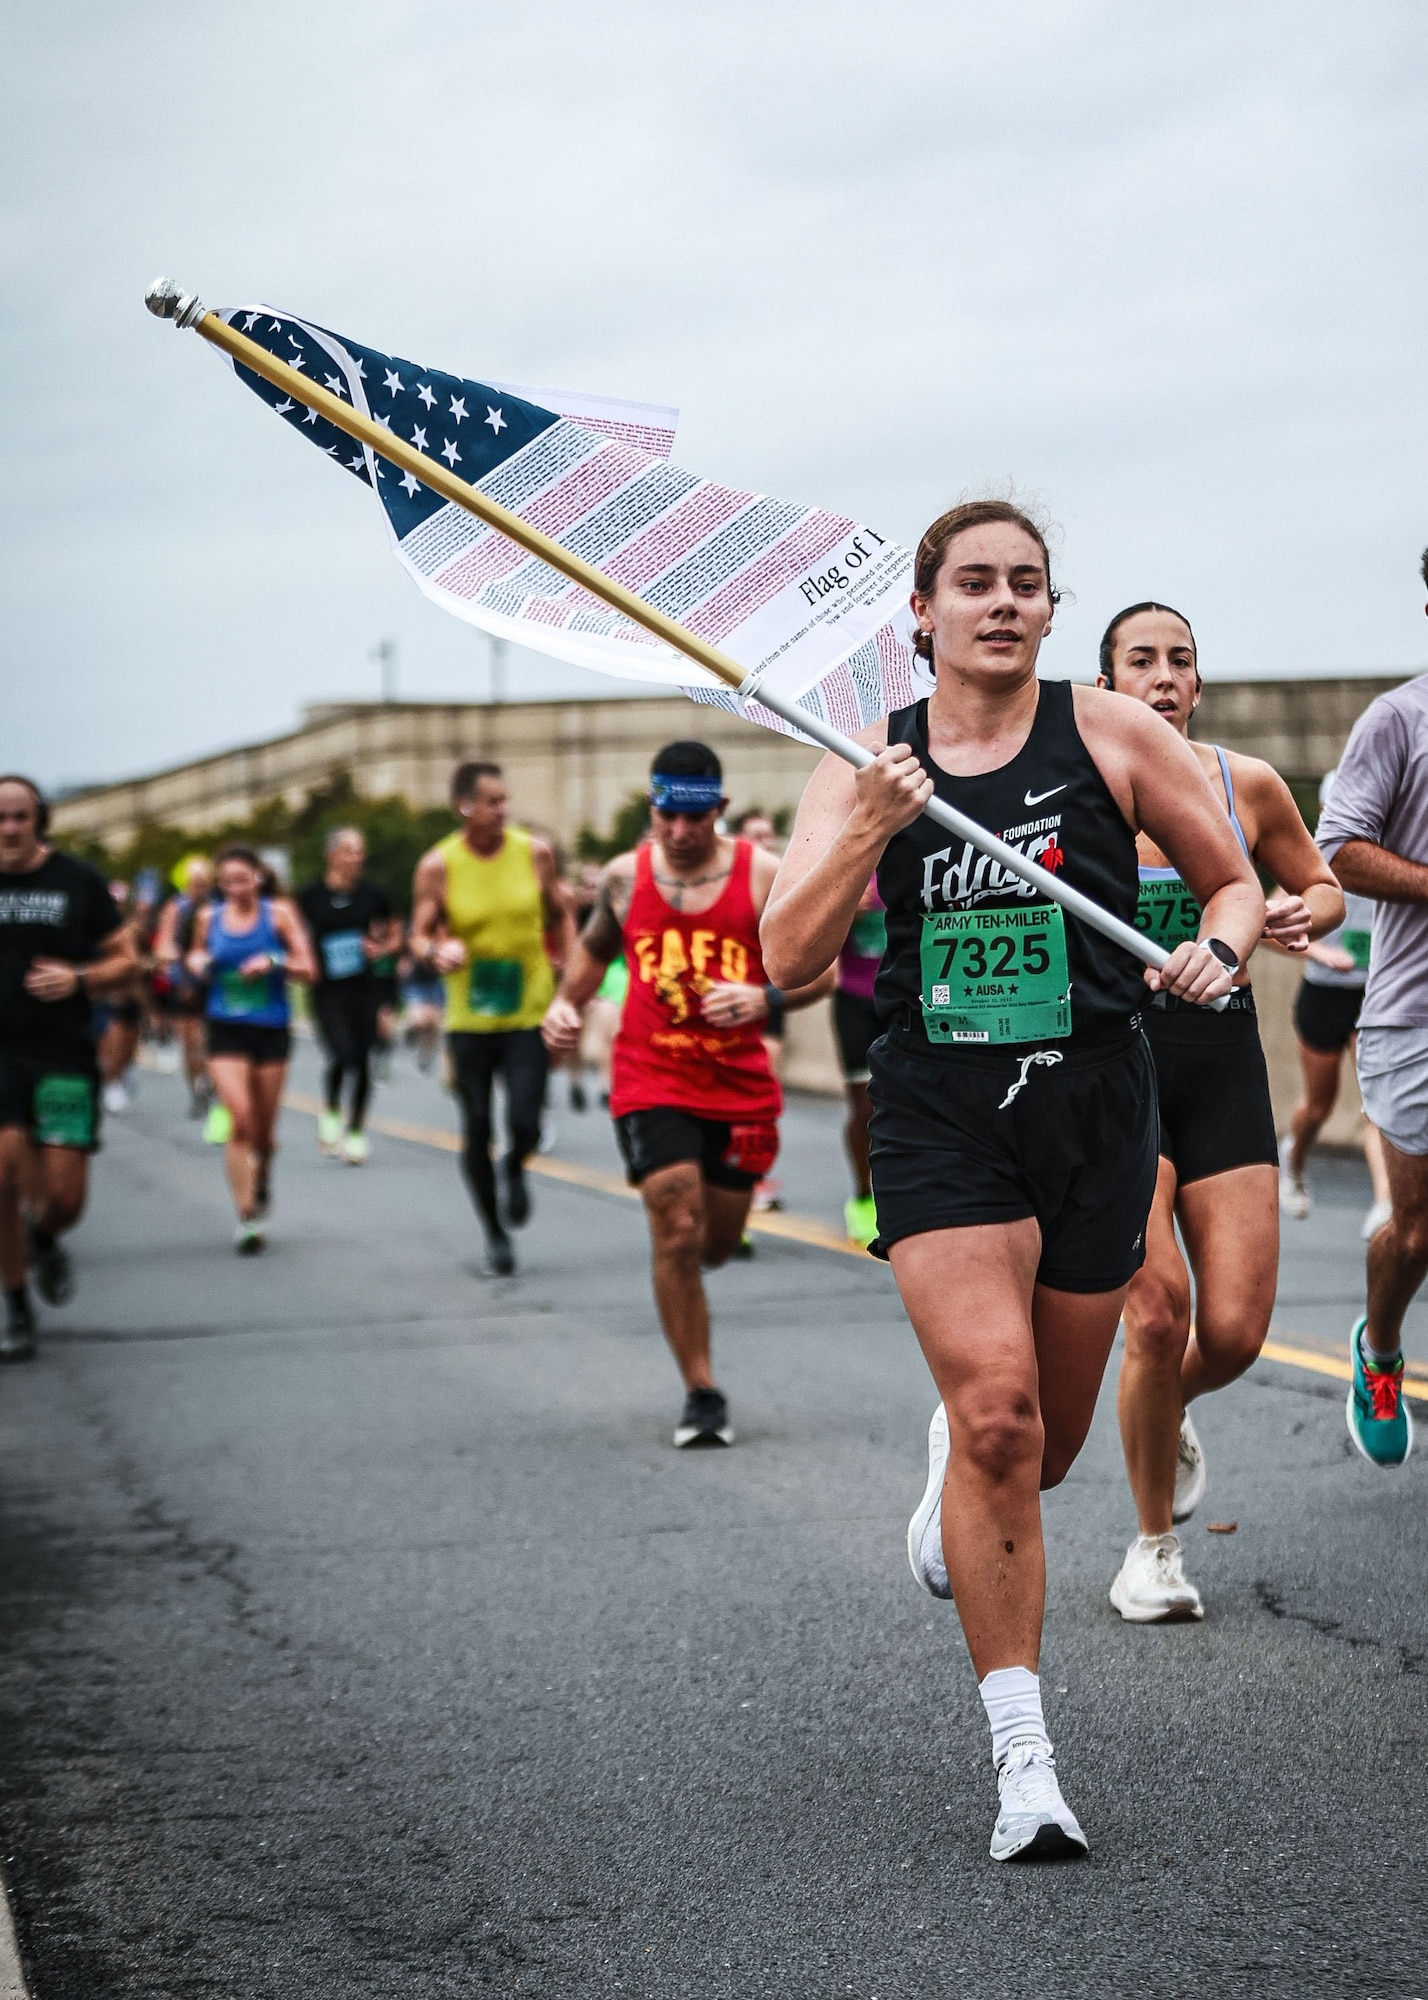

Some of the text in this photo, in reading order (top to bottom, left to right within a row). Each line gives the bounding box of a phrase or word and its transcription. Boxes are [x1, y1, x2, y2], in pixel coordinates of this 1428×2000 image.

[799, 566, 849, 606] Flag
[845, 536, 872, 568] of
[876, 580, 893, 597] shall
[892, 562, 912, 581] never
[765, 651, 781, 664] from
[779, 642, 791, 652] the
[790, 627, 809, 644] names
[815, 608, 832, 622] those
[831, 596, 846, 608] who
[846, 570, 875, 597] perished
[882, 550, 896, 562] the
[841, 602, 854, 614] and
[853, 581, 878, 604] forever
[1003, 814, 1062, 842] FOUNDATION
[1138, 882, 1188, 896] RMY TEN
[935, 910, 1051, 931] ARMY TEN-MILER
[1134, 898, 1201, 931] 575
[933, 933, 1050, 979] 7325
[976, 984, 1005, 996] AUSA
